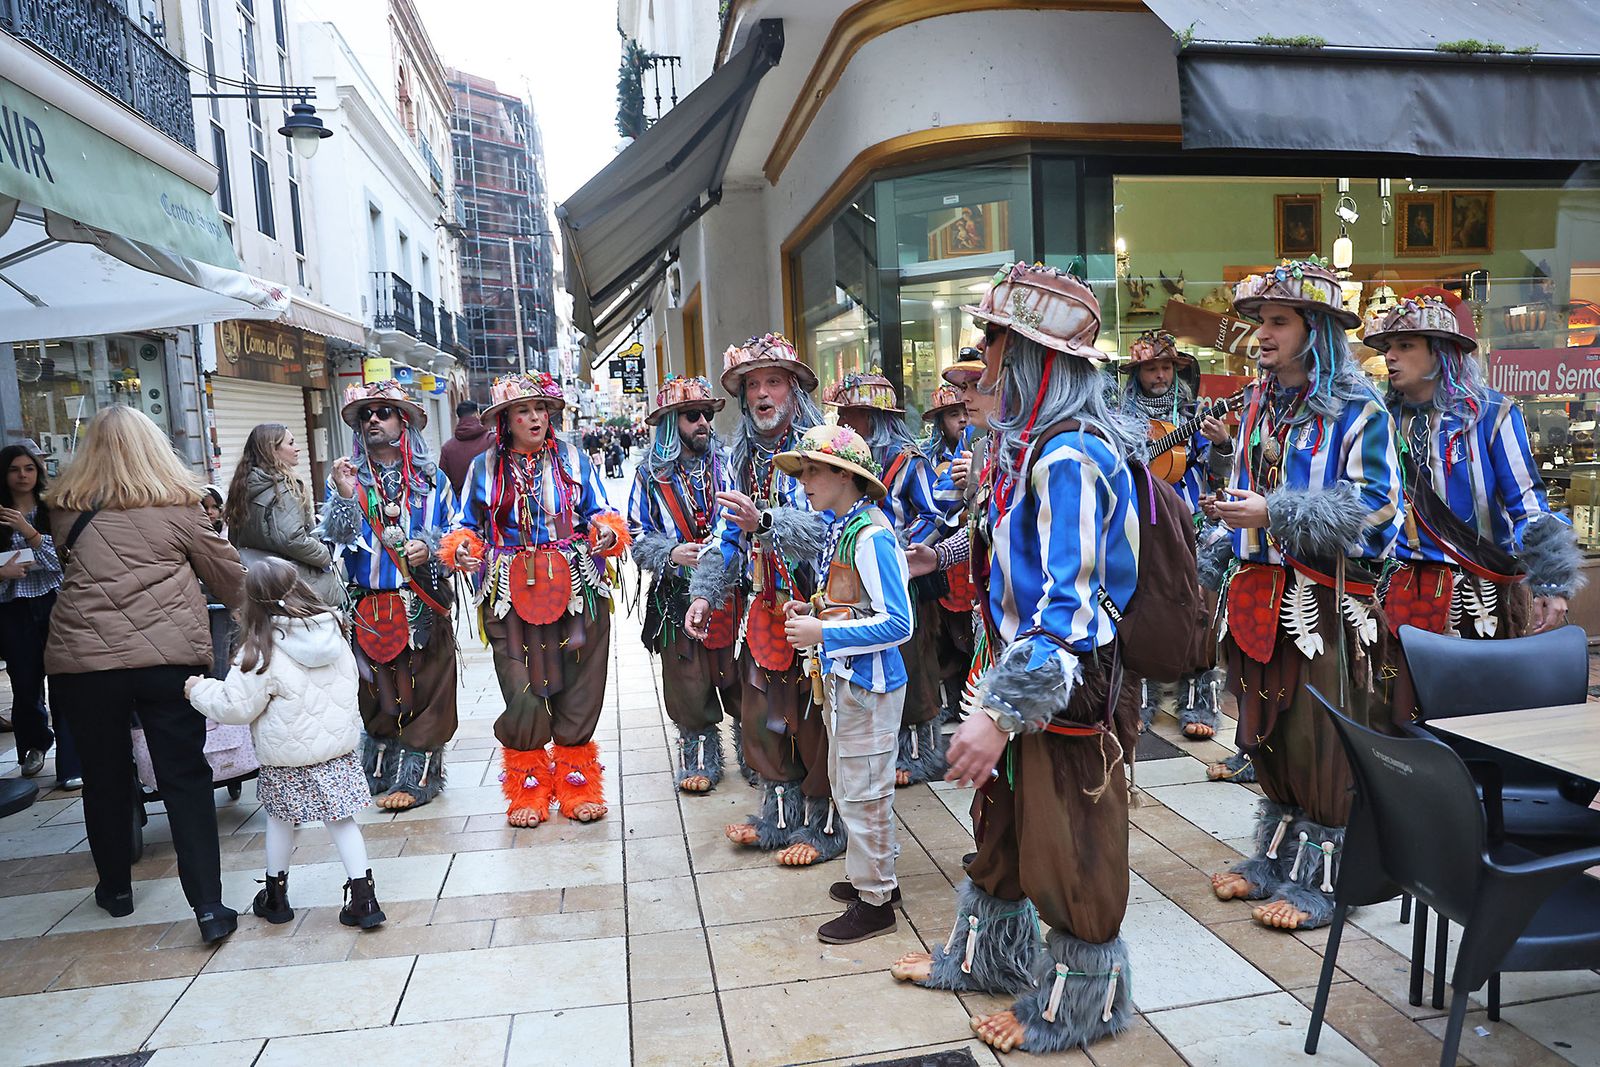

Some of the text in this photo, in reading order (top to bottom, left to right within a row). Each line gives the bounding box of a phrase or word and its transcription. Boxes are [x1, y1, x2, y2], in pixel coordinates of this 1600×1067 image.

[244, 325, 266, 354] Como
[1215, 317, 1229, 350] Hasta
[1493, 356, 1550, 392] Última
